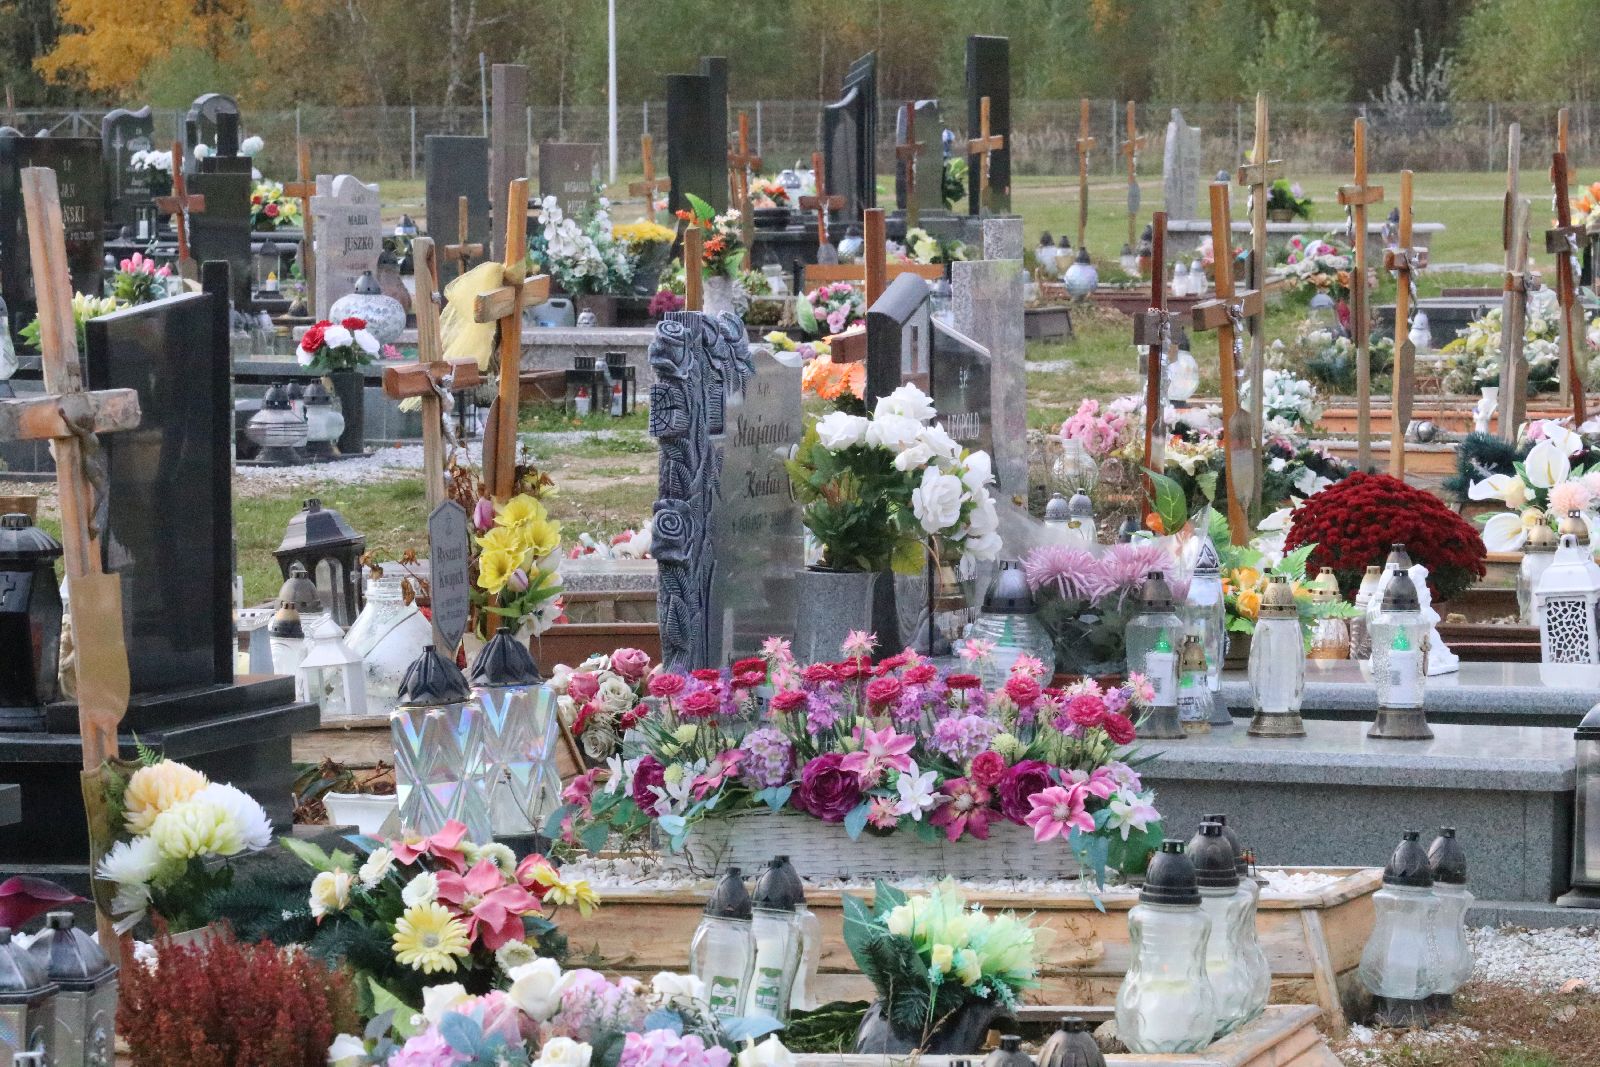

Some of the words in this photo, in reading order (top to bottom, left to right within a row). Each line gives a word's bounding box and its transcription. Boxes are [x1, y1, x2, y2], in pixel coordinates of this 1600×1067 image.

[63, 205, 84, 222] ŃSKI
[347, 215, 368, 225] MARIA
[343, 237, 373, 256] JUSZKO
[947, 412, 980, 439] LEOPOLD
